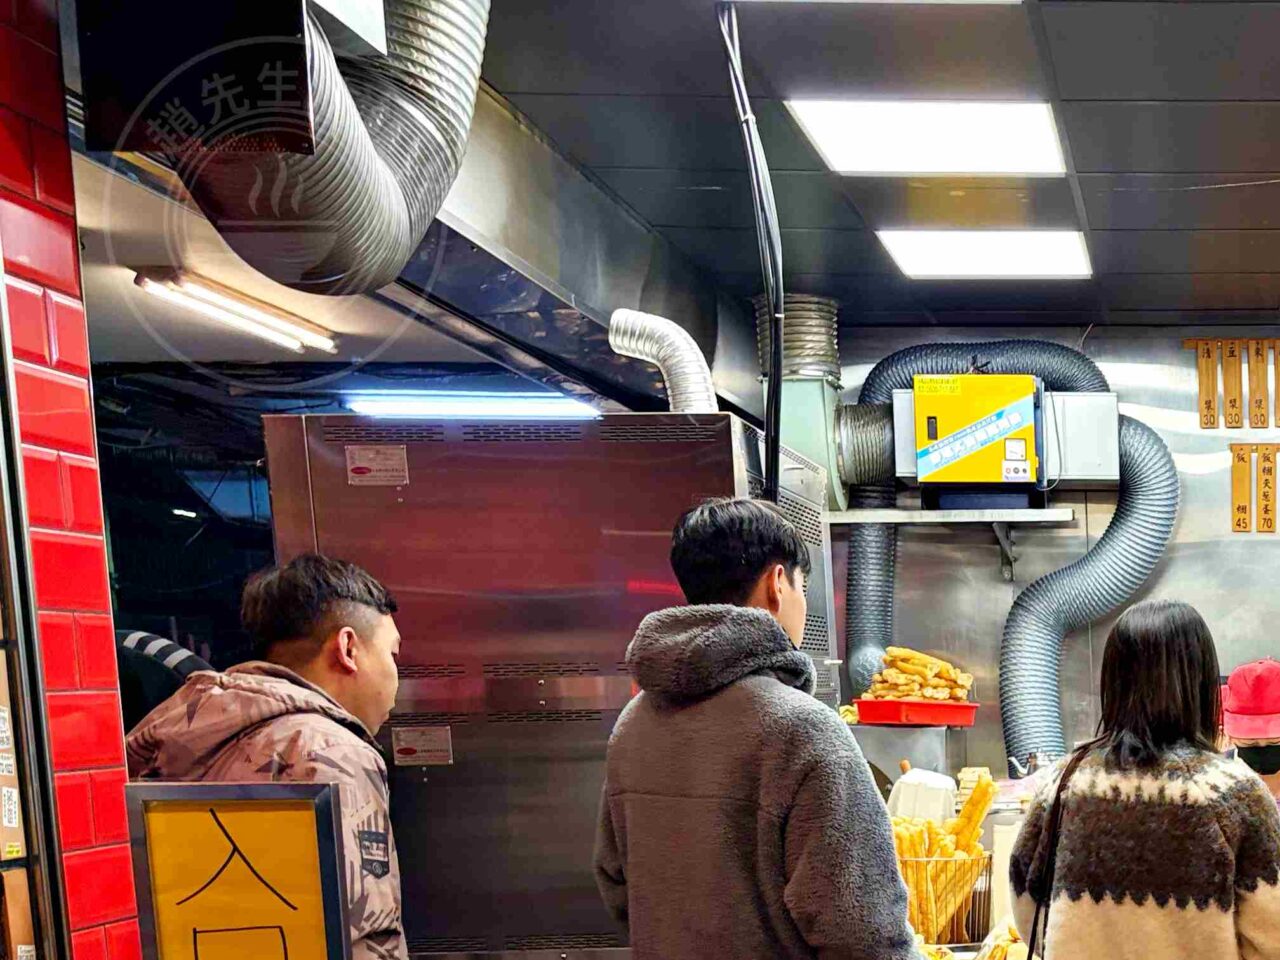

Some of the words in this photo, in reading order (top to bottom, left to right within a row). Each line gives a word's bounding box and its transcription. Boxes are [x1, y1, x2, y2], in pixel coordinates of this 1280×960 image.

[1203, 413, 1216, 425] 30
[1227, 413, 1240, 424] 30
[1253, 413, 1266, 425] 30
[1235, 517, 1248, 529] 45
[1262, 518, 1273, 528] 70
